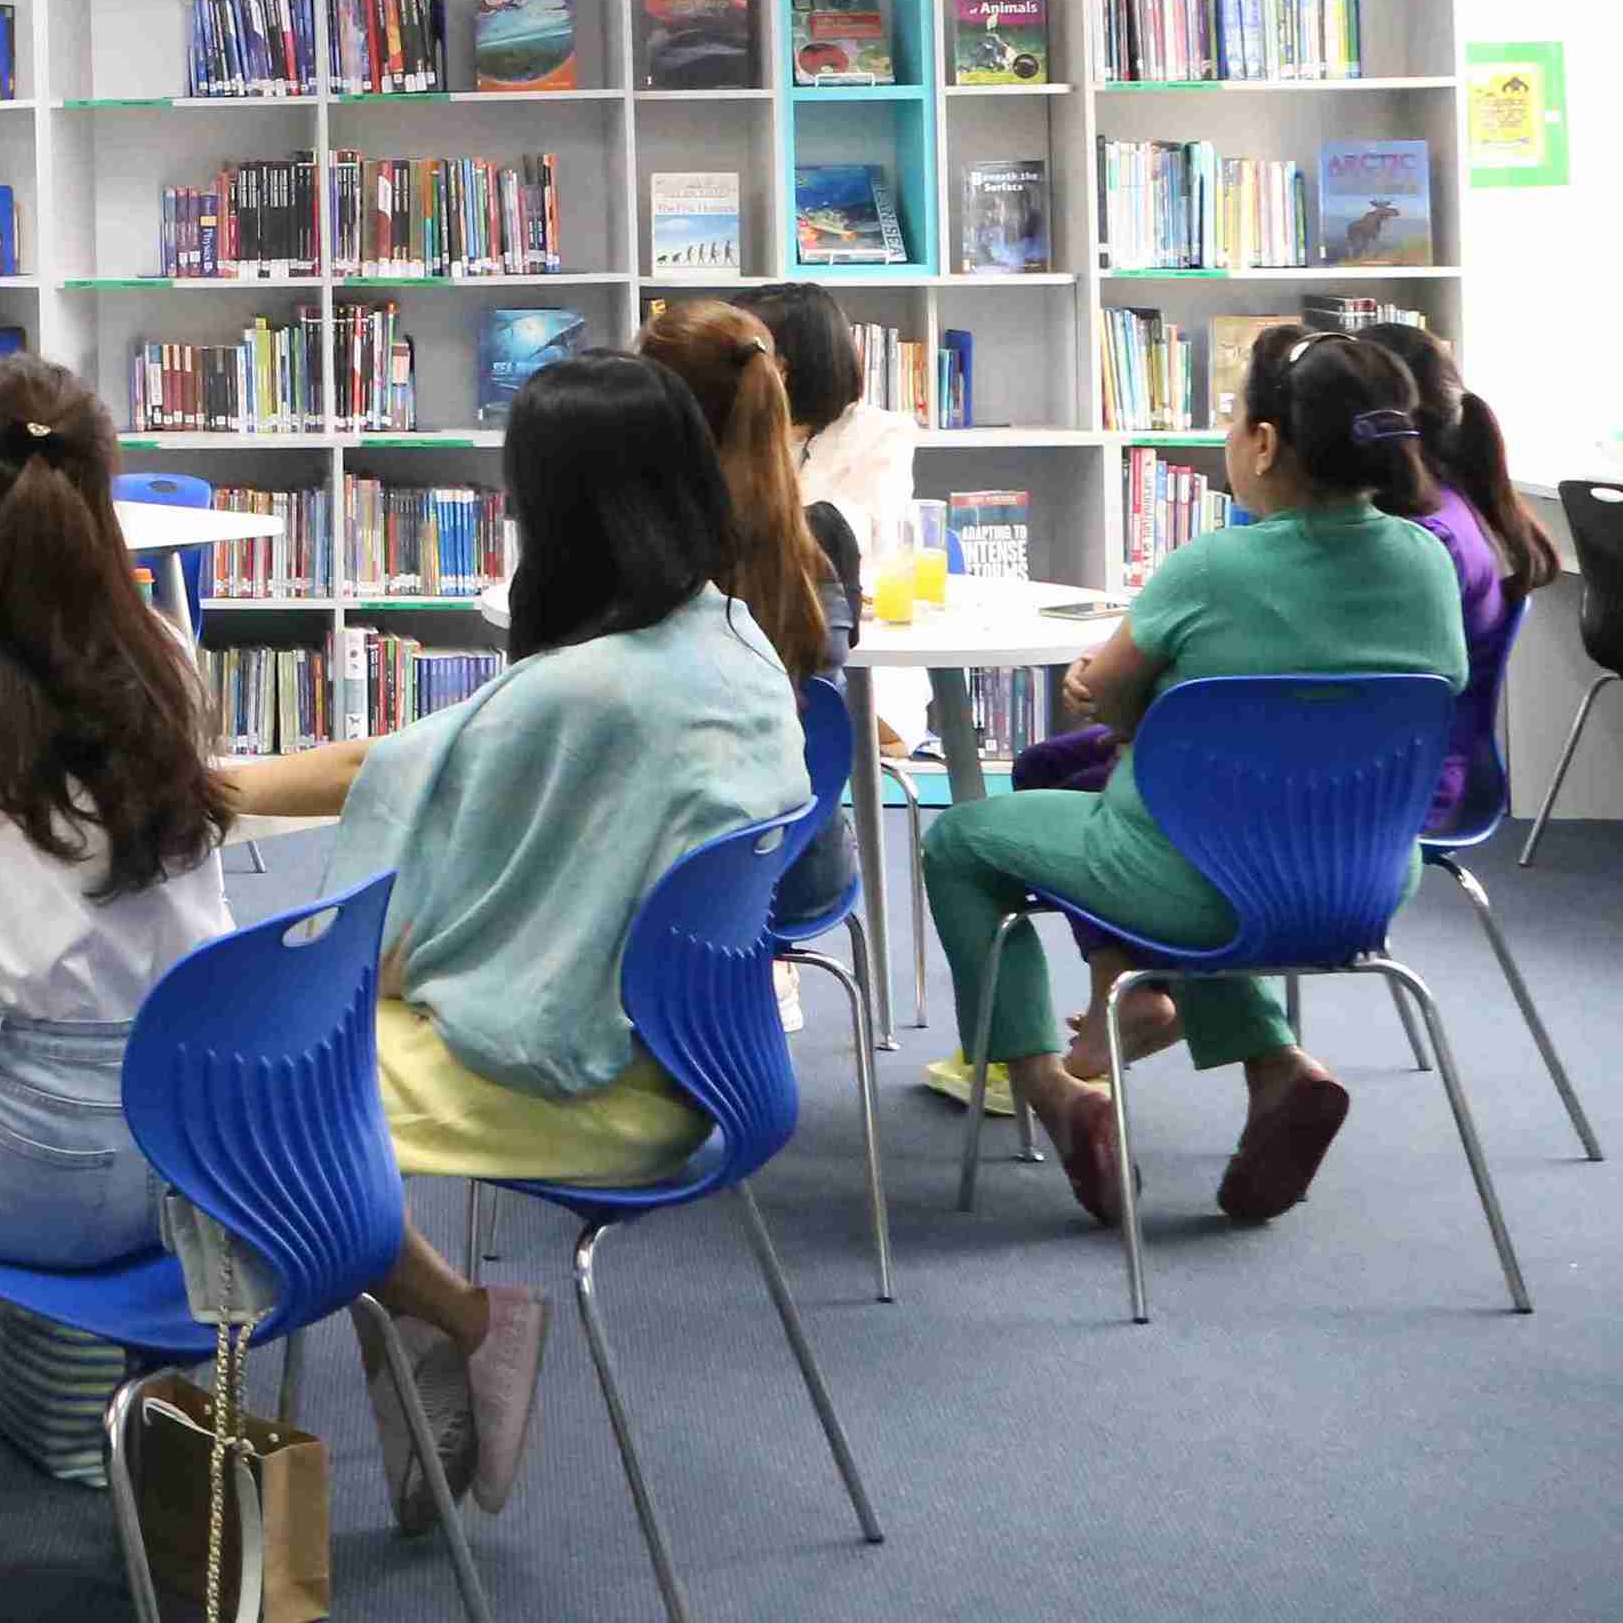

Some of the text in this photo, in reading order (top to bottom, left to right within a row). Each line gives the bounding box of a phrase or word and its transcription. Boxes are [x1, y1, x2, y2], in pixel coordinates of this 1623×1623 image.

[980, 1, 1038, 14] Animals
[1329, 153, 1417, 170] ARCTIC
[1013, 525, 1028, 539] TO
